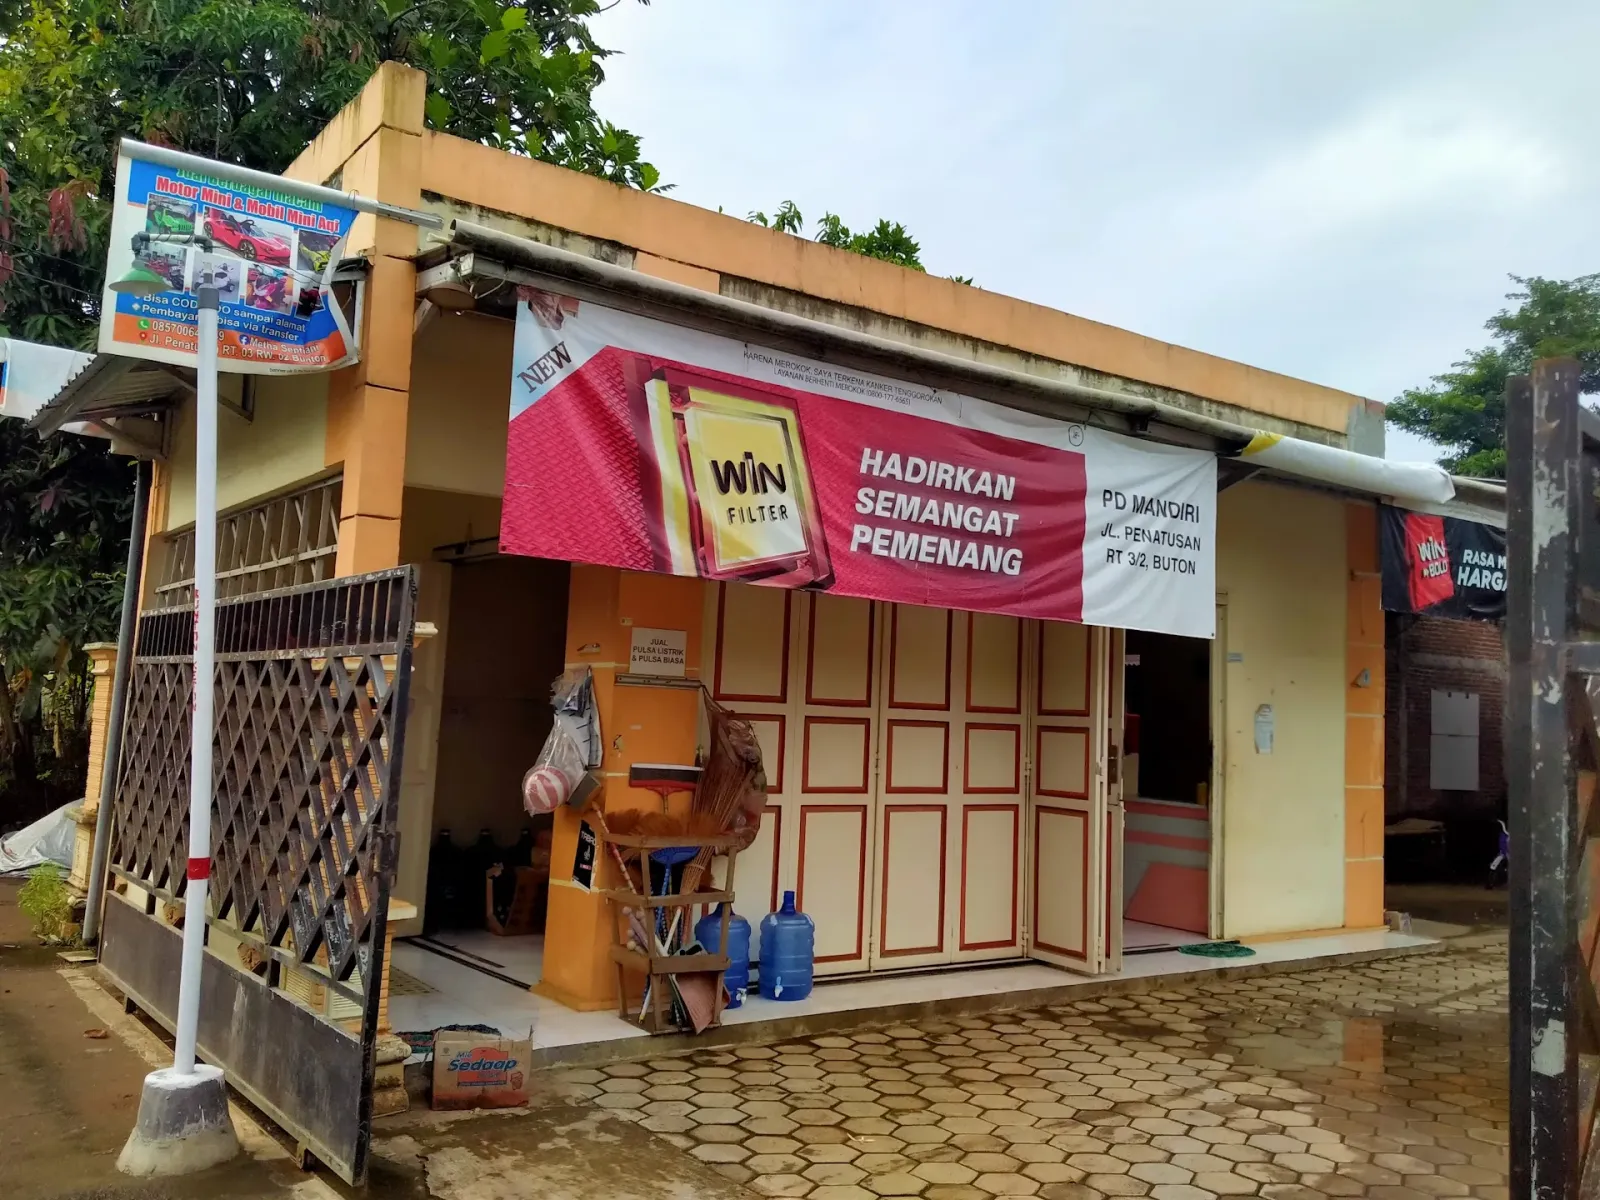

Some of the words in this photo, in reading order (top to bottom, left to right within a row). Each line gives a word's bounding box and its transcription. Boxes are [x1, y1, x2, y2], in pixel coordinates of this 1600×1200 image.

[156, 176, 198, 199] Motor
[200, 187, 231, 208] Mini
[233, 198, 244, 211] &
[247, 199, 285, 220] Mobil
[287, 208, 316, 227] Mini
[318, 216, 340, 232] Aqi
[233, 309, 273, 323] sampai
[276, 317, 306, 332] alamat
[243, 322, 258, 331] via
[261, 325, 299, 341] transfer
[241, 349, 253, 358] 03
[516, 341, 572, 393] NEW
[743, 350, 773, 365] KARENA
[813, 367, 832, 379] SAYA
[833, 372, 865, 385] TERKENA
[866, 380, 893, 392] KANKER
[894, 386, 943, 404] TENGGOROKAN
[774, 368, 804, 381] LAYANAN
[805, 374, 834, 387] BERHENTI
[835, 382, 865, 395] MEROKOK
[859, 447, 1016, 502] HADIRKAN
[727, 504, 789, 525] FILTER
[855, 487, 1020, 538] SEMANGAT
[1102, 489, 1127, 511] PD
[1132, 495, 1200, 524] MANDIRI
[850, 524, 1023, 577] PEMENANG
[1124, 527, 1201, 552] PENATUSAN
[1106, 547, 1123, 565] RT
[1152, 554, 1196, 575] BUTON
[1429, 560, 1448, 577] BOLD
[1462, 549, 1495, 568] RASA
[632, 646, 656, 654] PULSA
[657, 648, 684, 656] LISTRIK
[650, 638, 668, 646] JUAL
[638, 655, 662, 663] PULSA
[663, 657, 684, 665] BIASA
[447, 1058, 518, 1073] Sedaap
